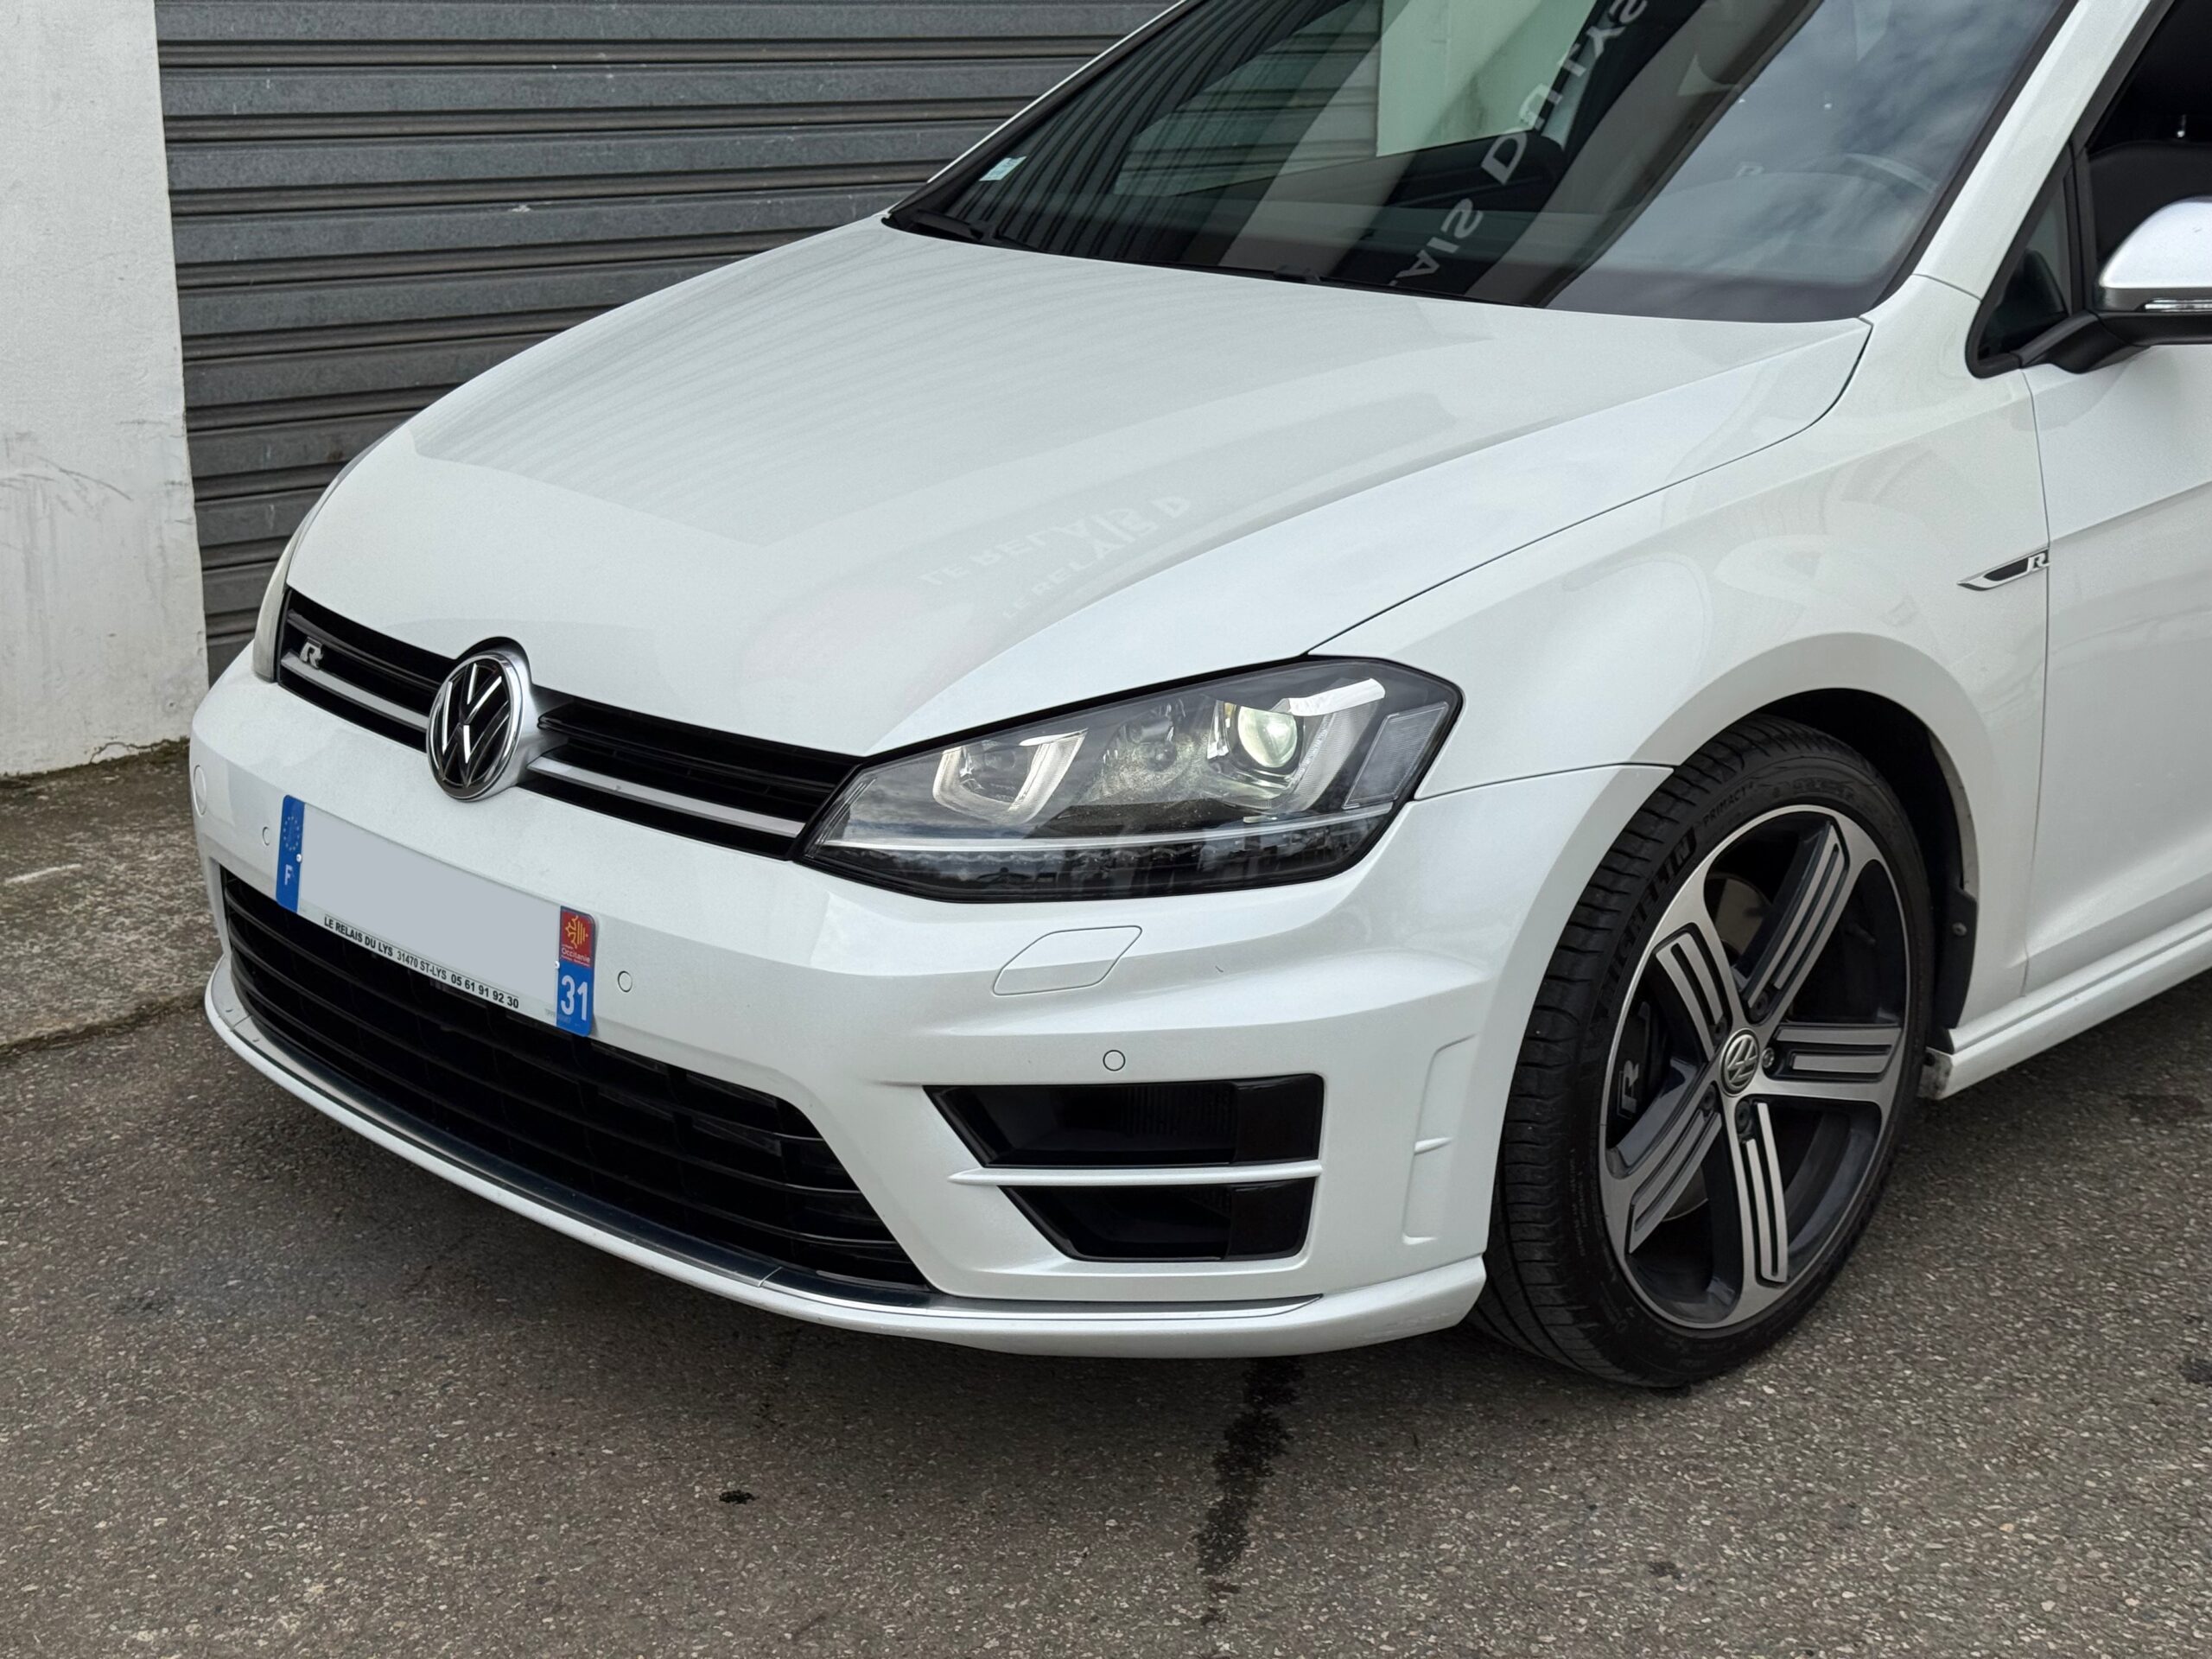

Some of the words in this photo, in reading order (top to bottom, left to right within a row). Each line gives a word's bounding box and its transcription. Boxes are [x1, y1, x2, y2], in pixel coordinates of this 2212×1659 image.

[2026, 552, 2051, 572] R
[300, 639, 323, 669] R
[284, 865, 293, 886] F
[324, 916, 334, 929] LE
[335, 922, 363, 943] RELAIS
[365, 935, 376, 949] DU
[378, 942, 393, 957] LYS
[397, 950, 418, 968] 31470
[420, 960, 447, 981] ST-LYS
[451, 974, 462, 987] 05
[465, 979, 475, 992] 61
[479, 984, 490, 998] 91
[493, 990, 505, 1004] 92
[507, 996, 519, 1009] 30
[561, 946, 591, 963] Occitanie
[560, 975, 588, 1021] 31
